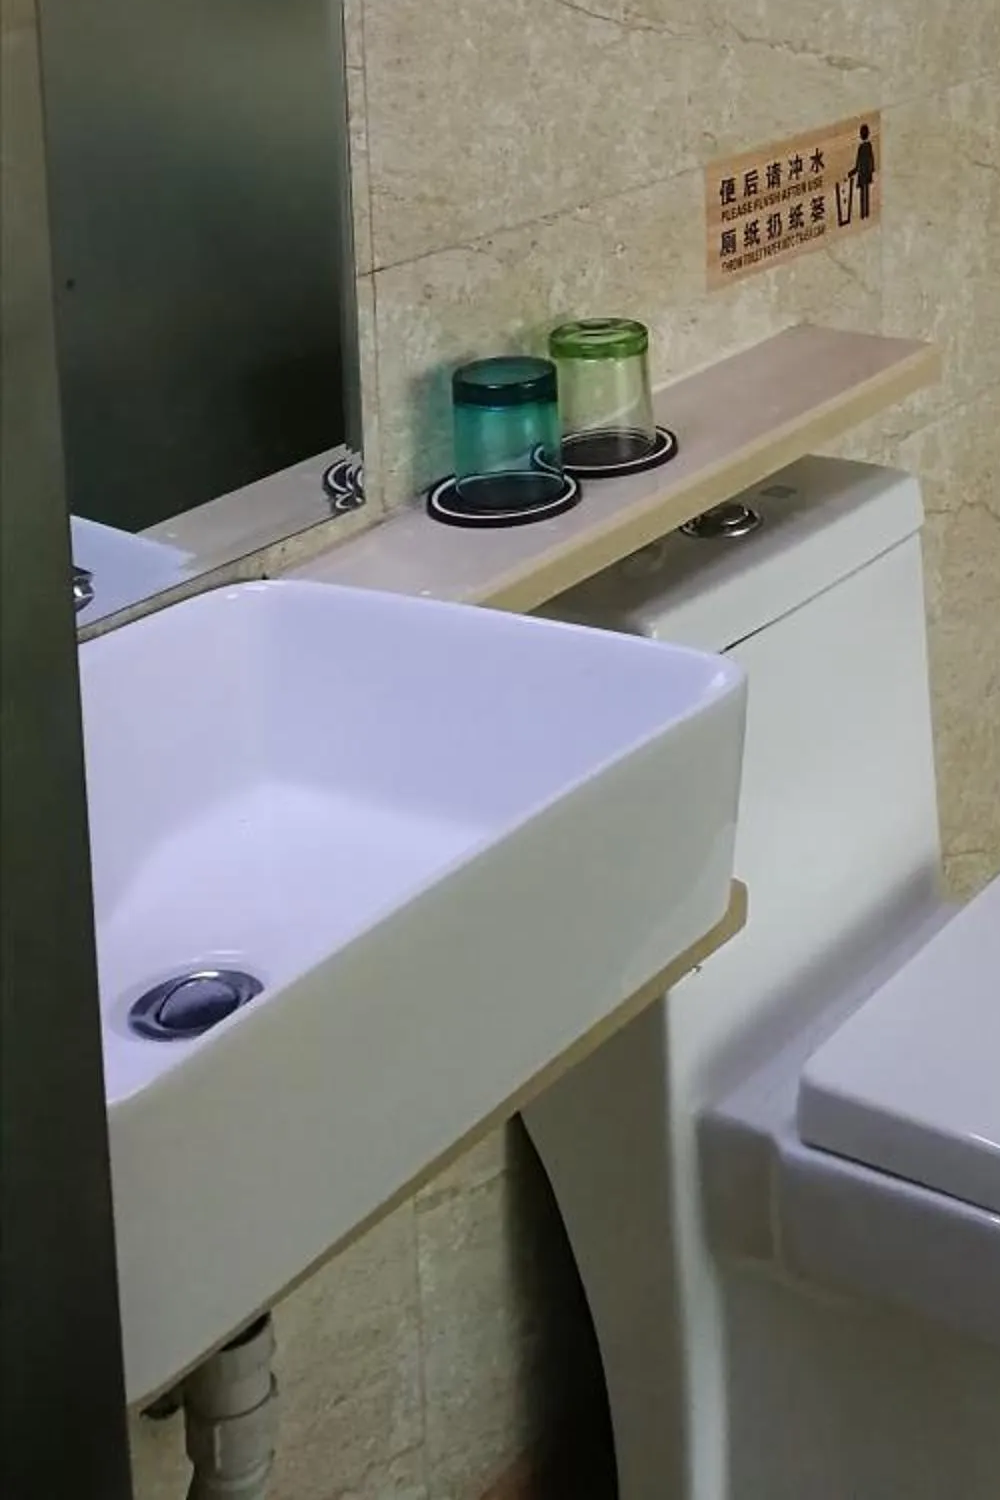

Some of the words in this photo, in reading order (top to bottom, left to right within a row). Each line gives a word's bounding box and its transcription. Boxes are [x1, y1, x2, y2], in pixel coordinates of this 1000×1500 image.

[719, 147, 826, 206] 便后请冲水
[721, 201, 753, 221] PLEASE
